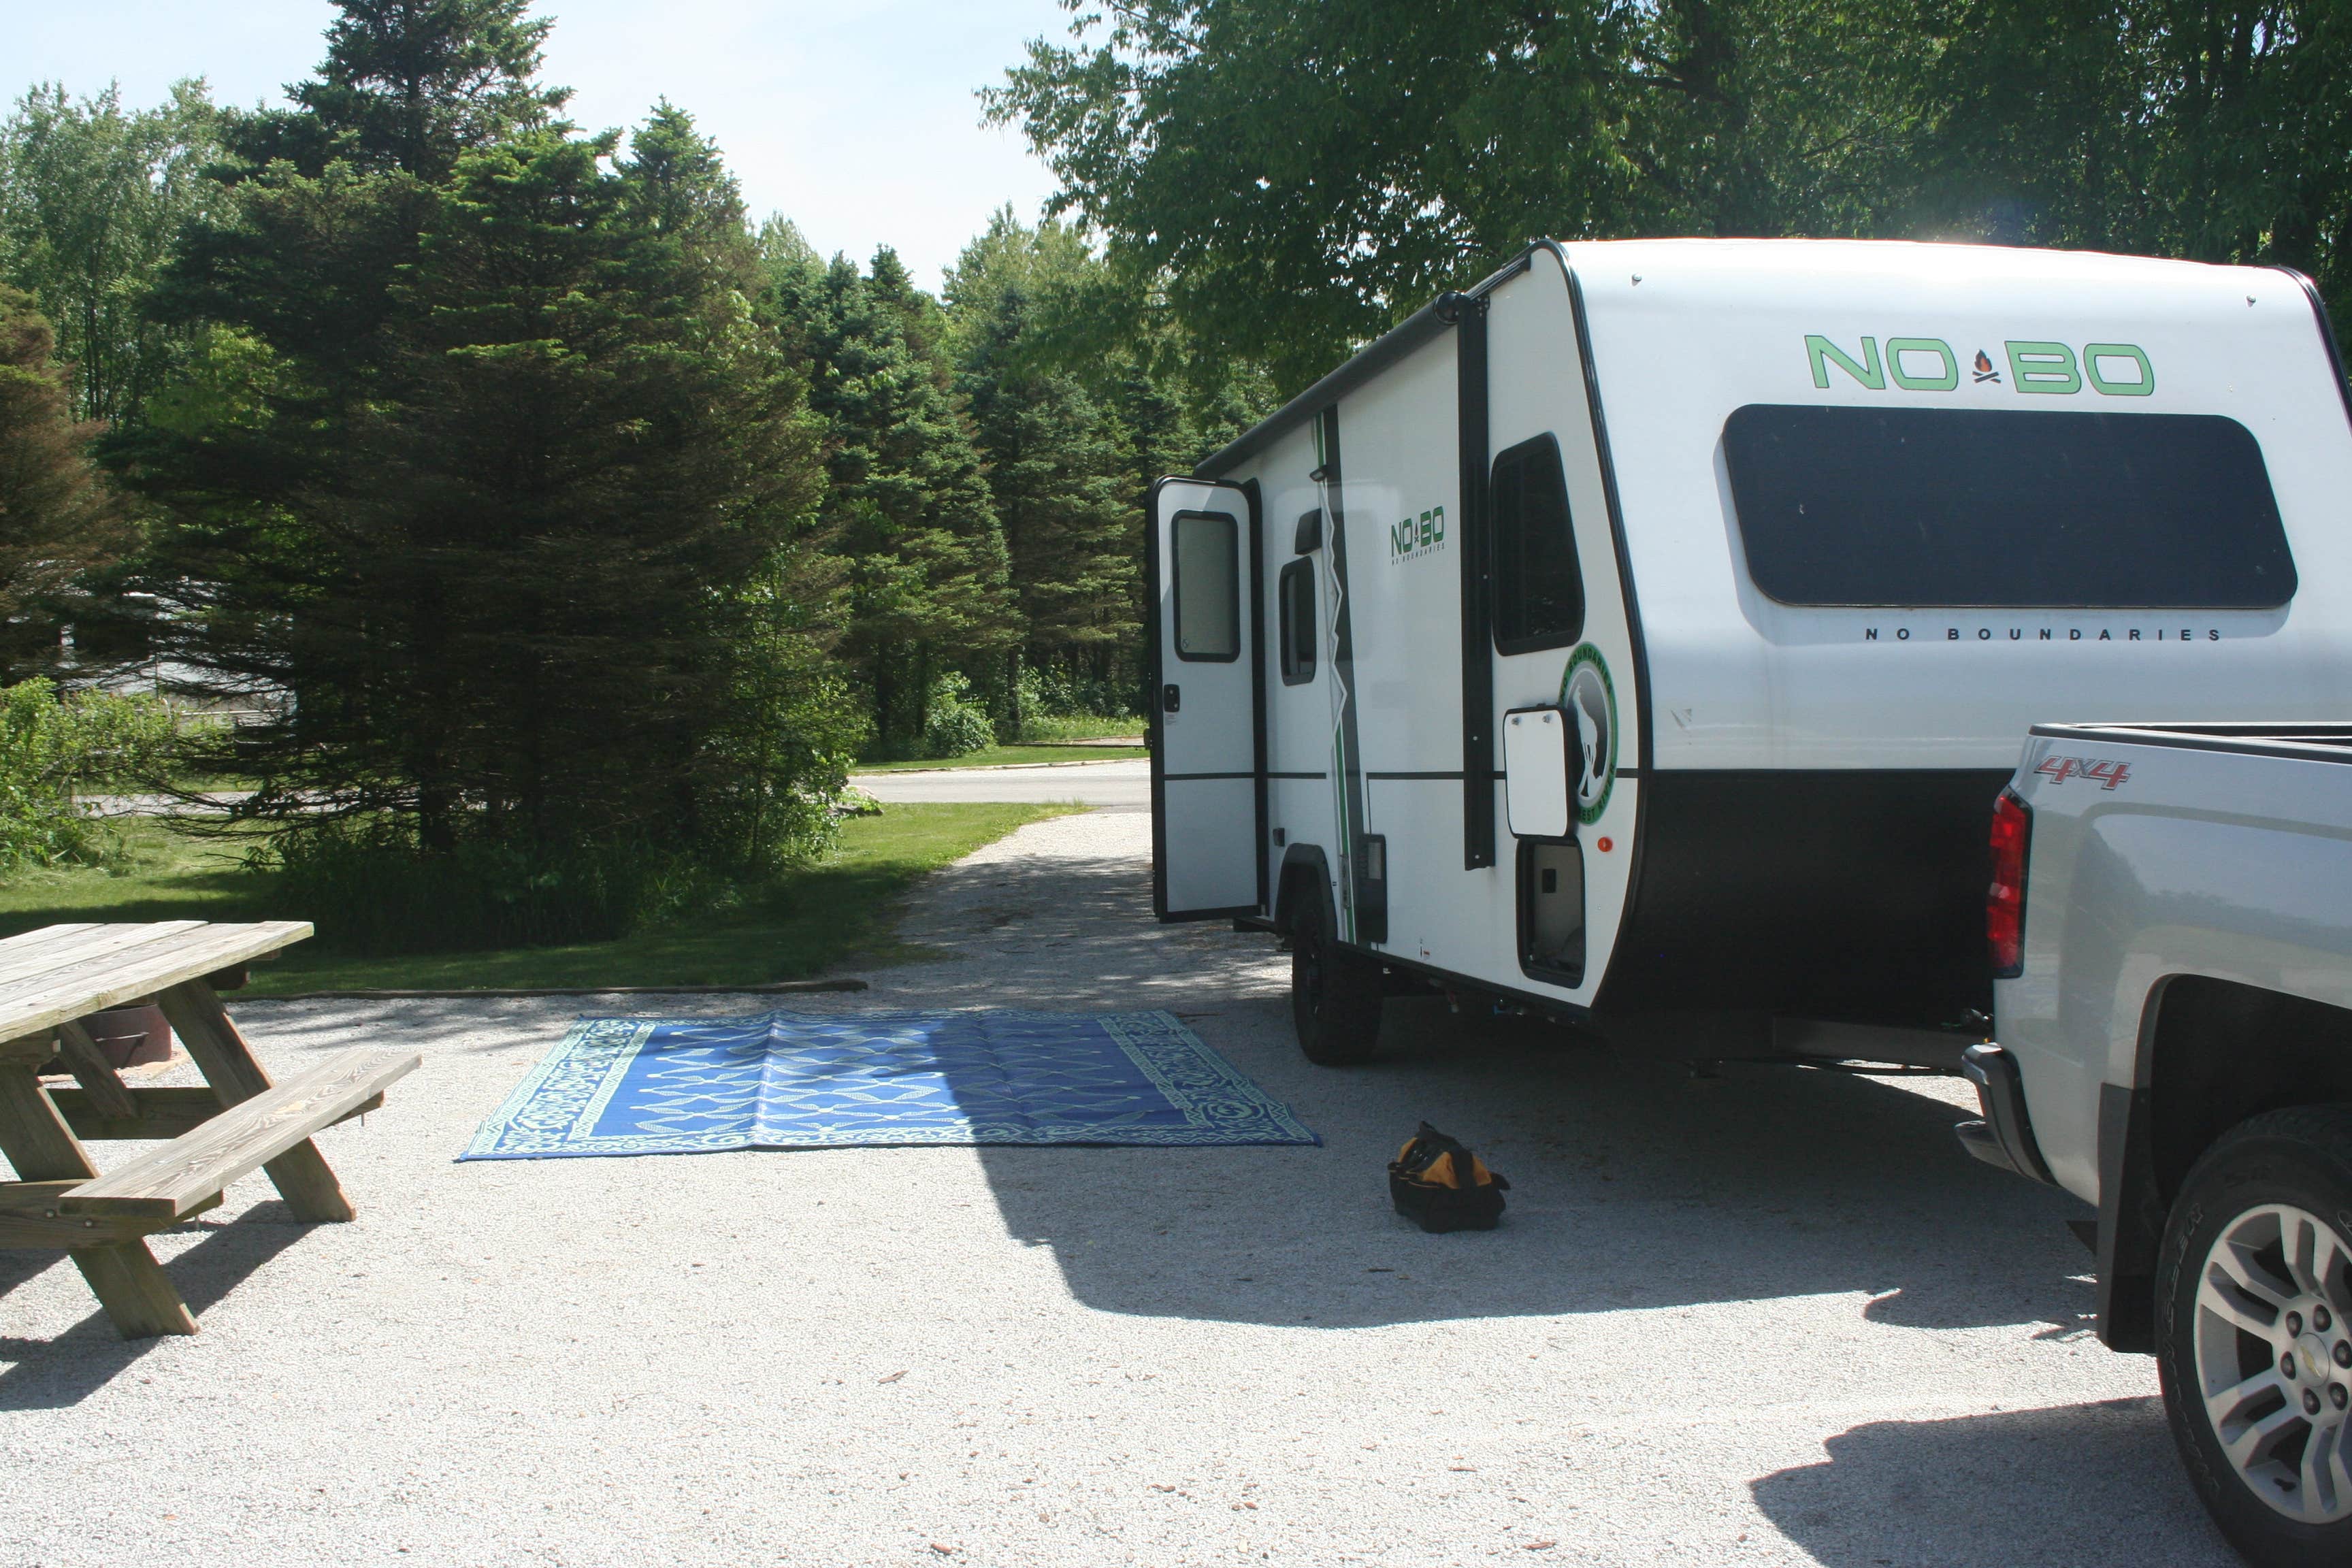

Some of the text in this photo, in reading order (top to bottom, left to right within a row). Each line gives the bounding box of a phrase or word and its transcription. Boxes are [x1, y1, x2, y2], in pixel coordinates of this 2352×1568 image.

[1804, 335, 2155, 396] NO BO
[1391, 506, 1444, 557] NO BO
[1865, 628, 2219, 641] NO BOUNDARIES
